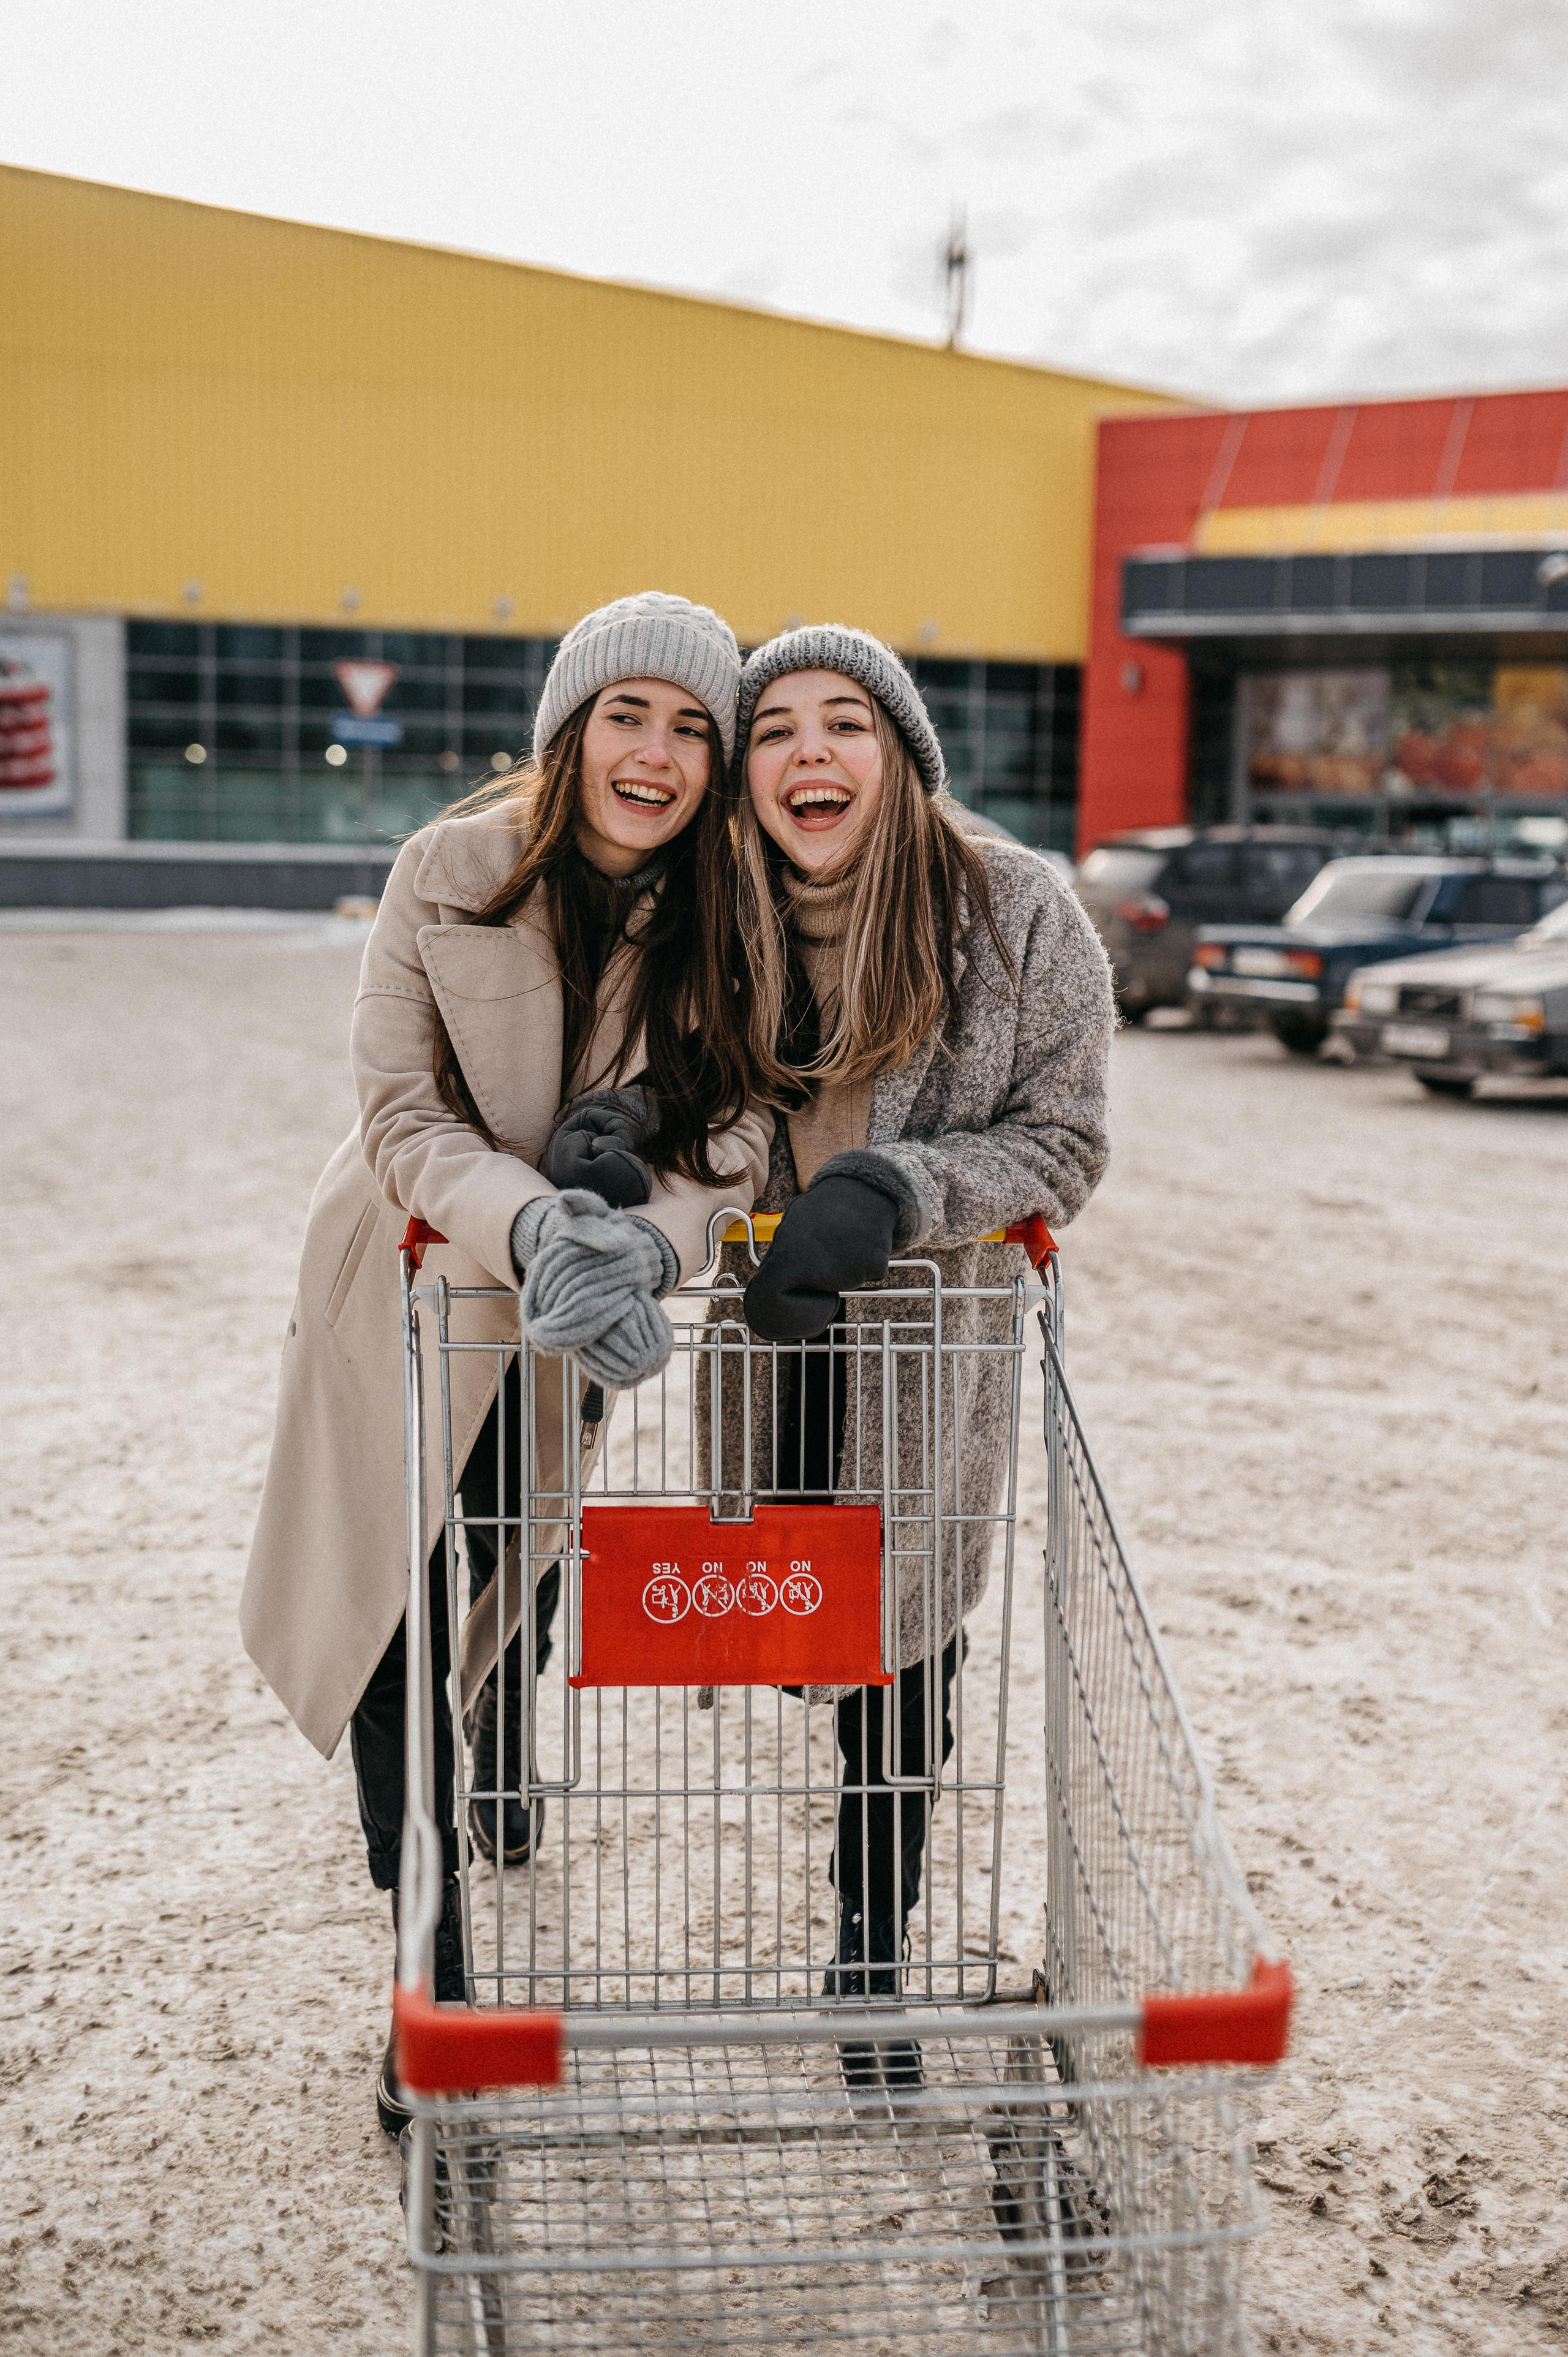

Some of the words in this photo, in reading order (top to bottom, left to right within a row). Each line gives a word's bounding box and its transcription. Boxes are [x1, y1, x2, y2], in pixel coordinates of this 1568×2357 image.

[652, 1562, 681, 1574] YES
[702, 1561, 723, 1573] NO
[746, 1561, 767, 1573] NO
[790, 1560, 811, 1572] NO
